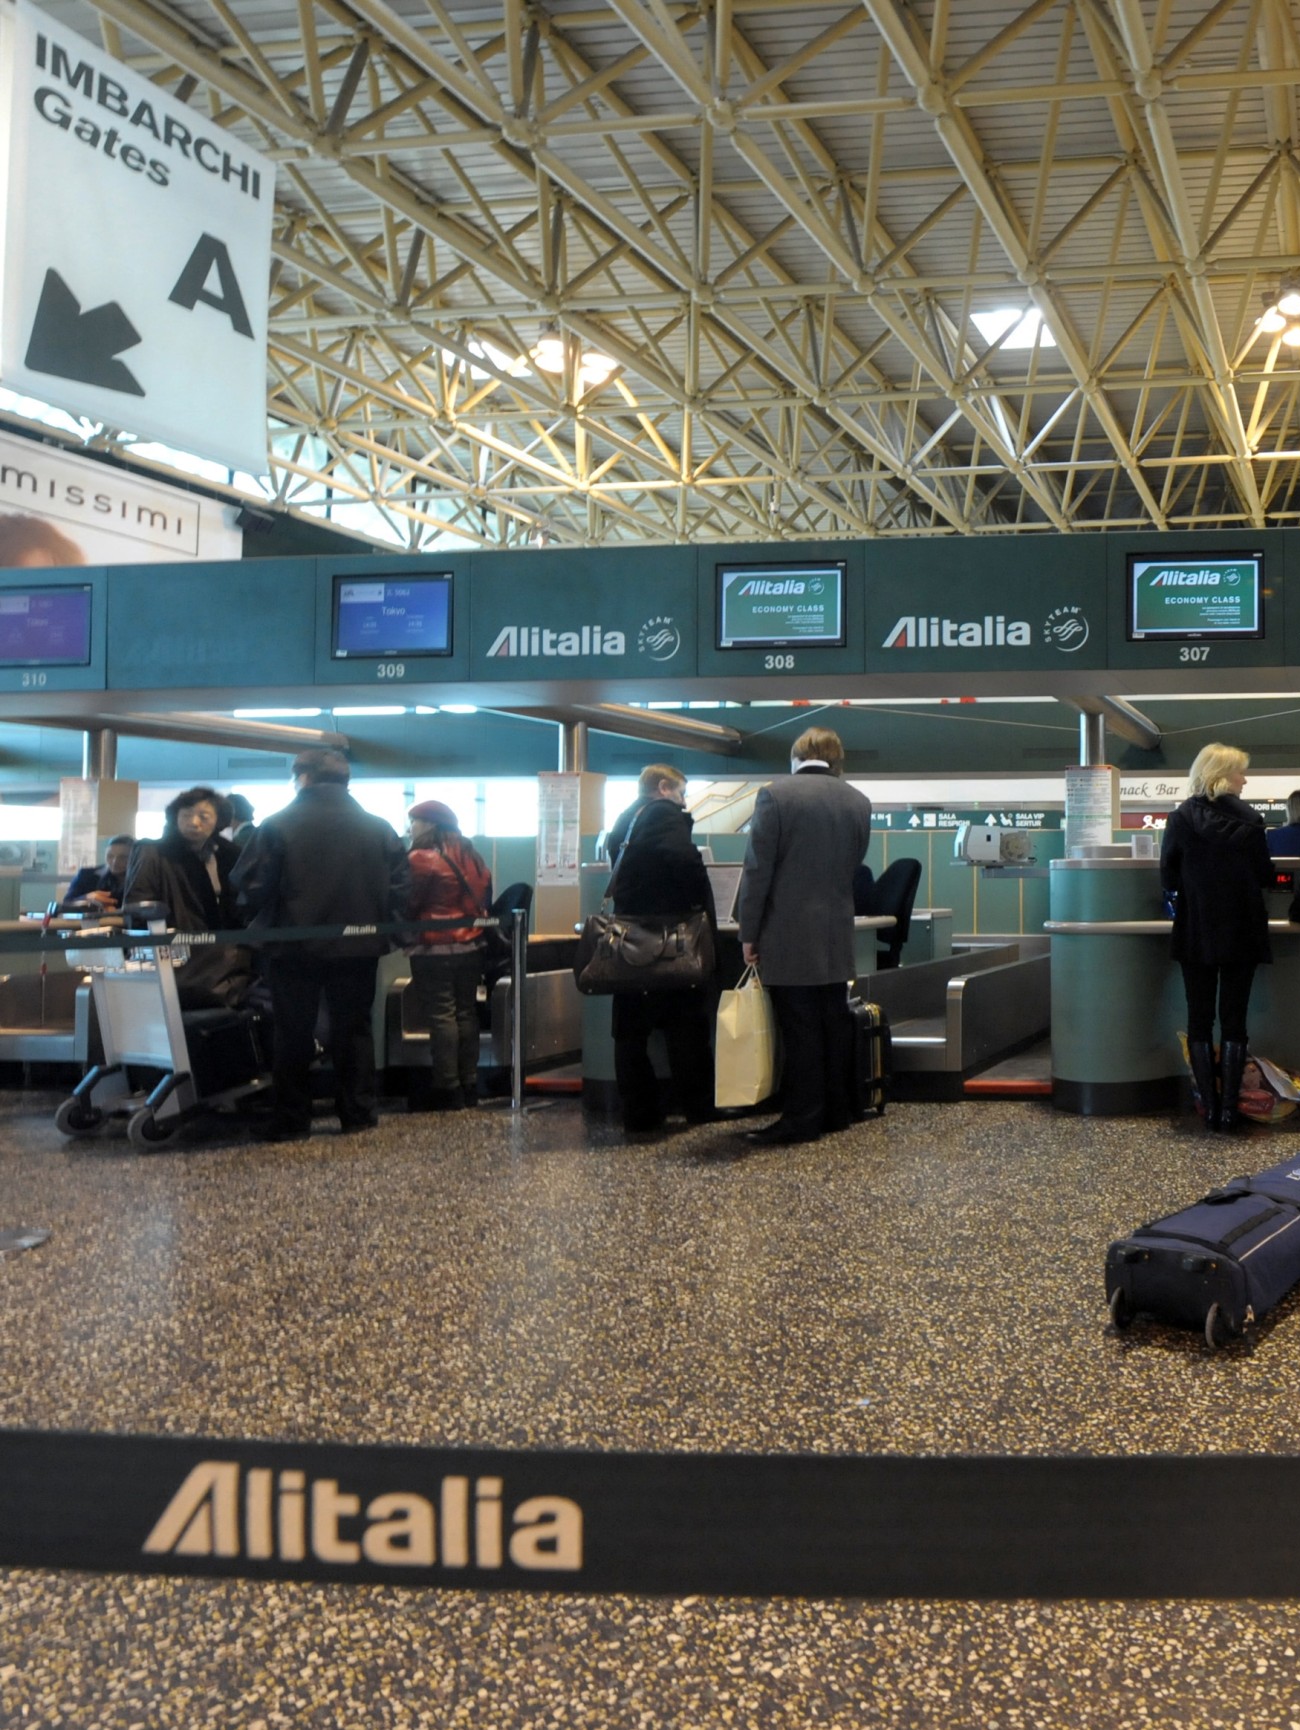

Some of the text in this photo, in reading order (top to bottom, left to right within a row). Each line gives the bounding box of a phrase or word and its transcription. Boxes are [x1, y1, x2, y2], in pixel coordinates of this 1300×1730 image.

[36, 31, 261, 200] IMBARCHI
[34, 85, 171, 188] Gates
[168, 231, 256, 341] A
[1149, 569, 1221, 587] Alitalia
[737, 579, 806, 597] Alitalia
[1164, 596, 1241, 605] ECONOMY CLASS
[751, 604, 825, 614] ECONOMY CLASS
[882, 615, 1031, 648] Alitalia
[1044, 606, 1082, 644] SKYTEAM
[486, 625, 626, 658] Alitalia
[764, 654, 795, 670] 308
[1179, 646, 1211, 662] 307
[376, 663, 405, 678] 309
[21, 672, 47, 688] 310
[1120, 782, 1180, 798] nack Bar
[885, 813, 892, 827] 1
[938, 812, 957, 820] SALA
[1015, 812, 1045, 820] SALA VIP
[343, 923, 377, 936] Alitalia
[473, 917, 500, 927] Alitalia
[171, 932, 217, 945] Alitalia
[142, 1460, 584, 1571] Alitalia
